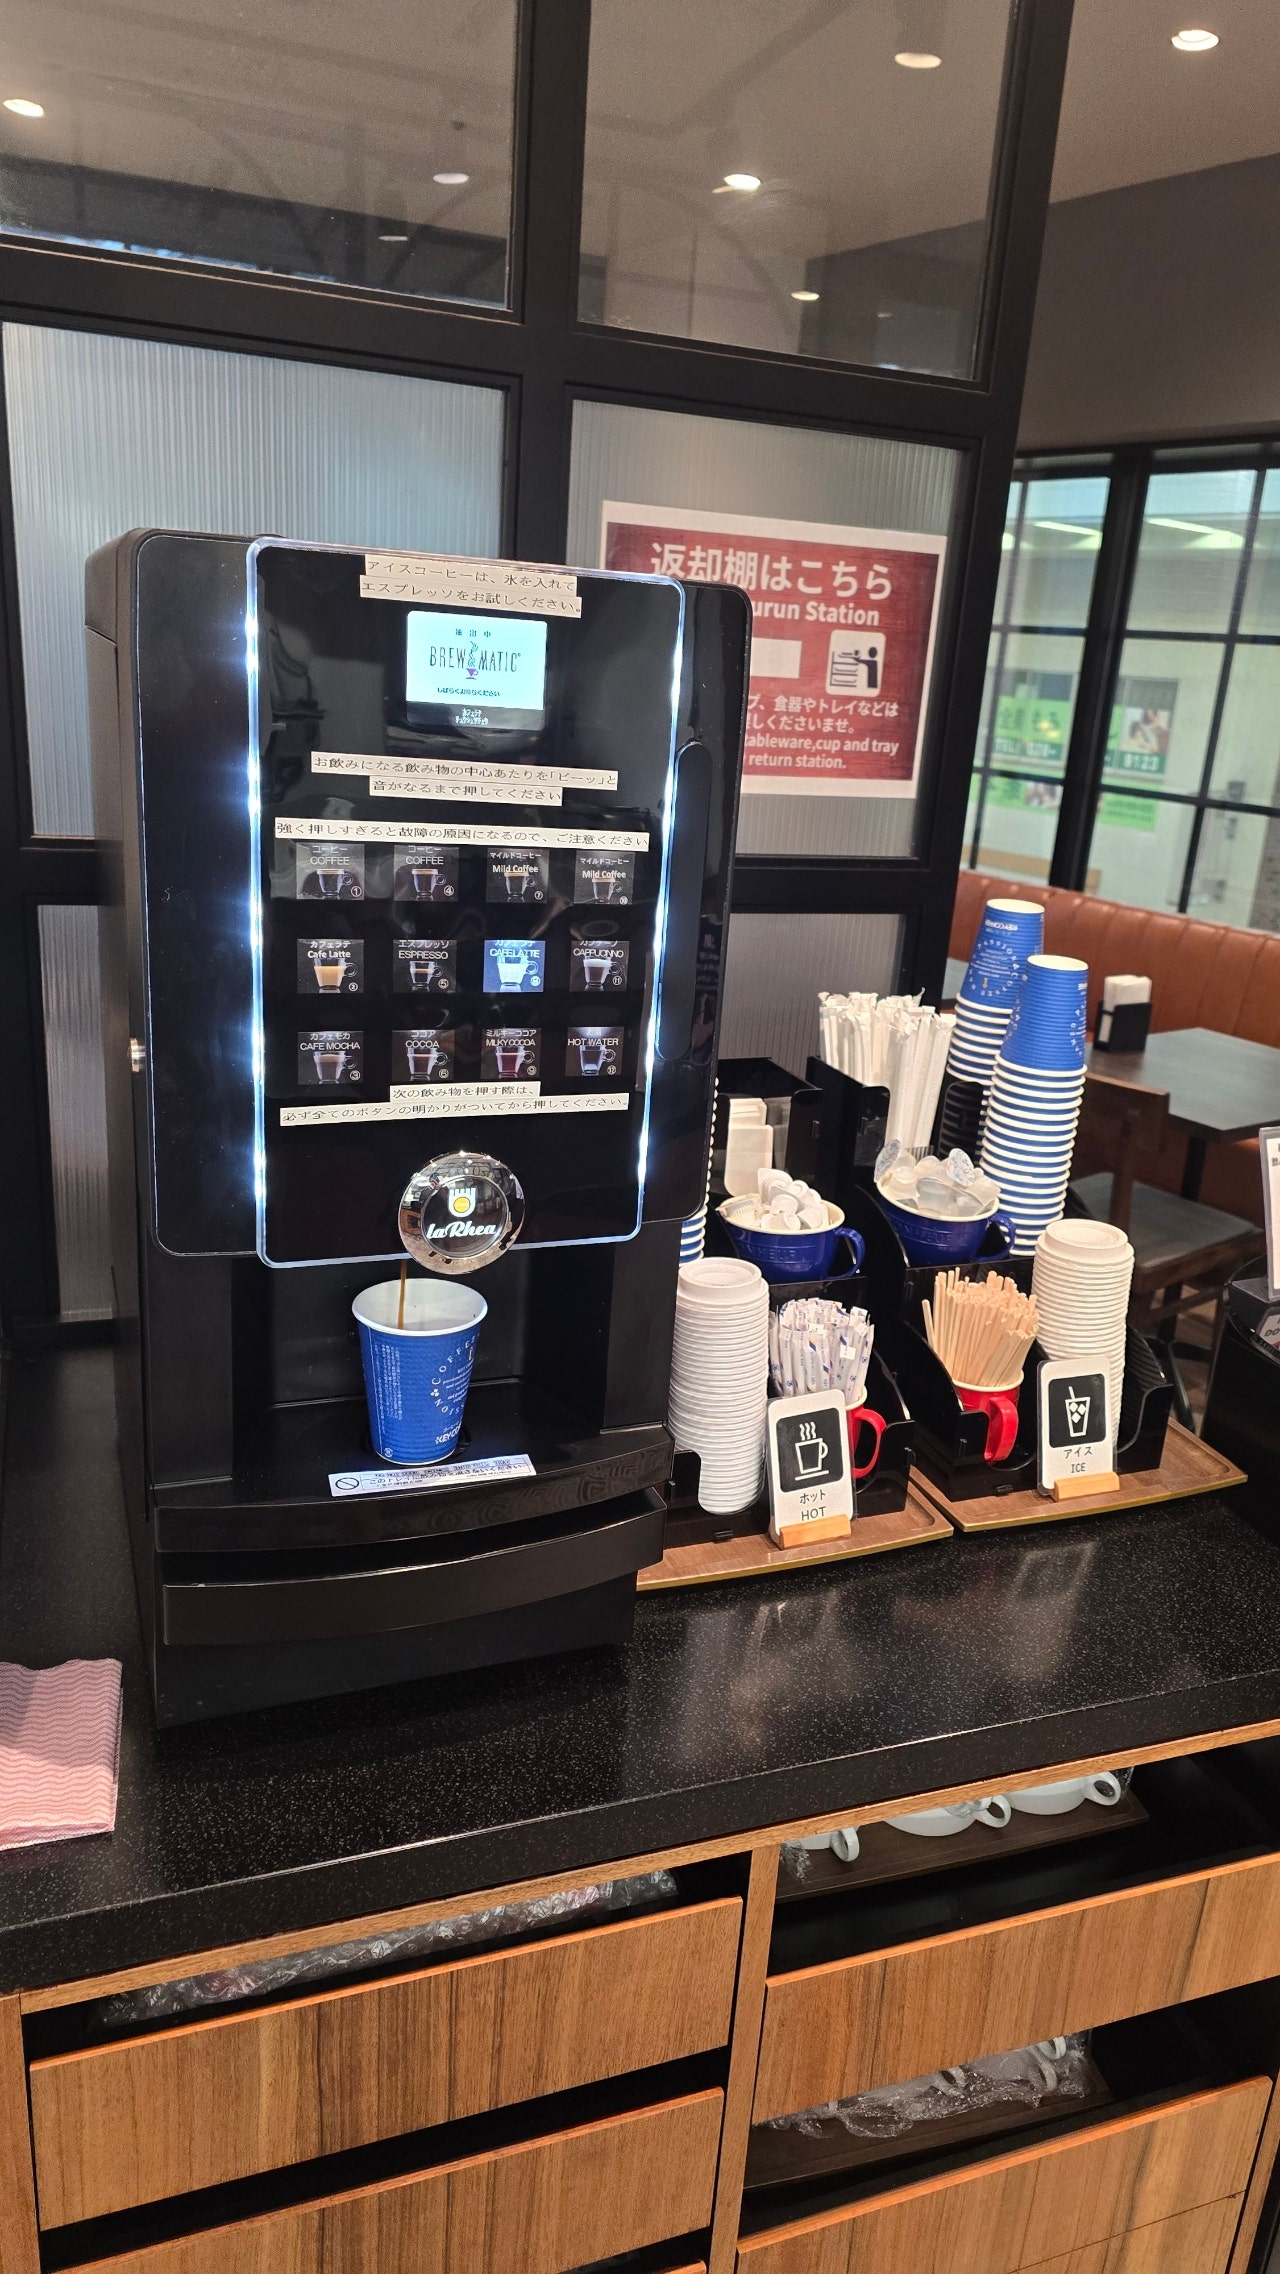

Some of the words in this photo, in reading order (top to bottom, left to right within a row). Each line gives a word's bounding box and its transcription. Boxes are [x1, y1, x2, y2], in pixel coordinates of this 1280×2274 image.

[367, 560, 575, 591] アイスコーヒーは、氷を入れて
[650, 541, 893, 601] 返却棚はこちら
[361, 582, 581, 613] エスプレッソをお試しください。
[805, 600, 880, 626] Station
[429, 645, 466, 669] BREW
[844, 738, 869, 752] and
[871, 740, 900, 757] tray
[749, 753, 792, 767] return
[795, 754, 847, 769] station.
[372, 780, 562, 800] 音がなるまで押してください
[276, 823, 648, 848] 強く押しすぎると故障の原因になるので、ご注意ください
[312, 845, 348, 854] コーヒー
[408, 845, 442, 854] コーヒー
[310, 856, 350, 865] COFFEE
[406, 856, 444, 865] COFFEE
[580, 858, 630, 866] マイルドコーヒー
[492, 865, 511, 873] Mild
[513, 864, 539, 873] Coffee
[582, 870, 600, 879] Mild
[602, 870, 627, 879] Coffee
[310, 941, 351, 949] カフェラテ
[308, 950, 327, 958] Cafe
[329, 950, 351, 958] Latte
[399, 951, 449, 959] ESPRESSO
[310, 1032, 351, 1040] カフェモカ
[411, 1030, 436, 1038] ココア
[485, 1029, 537, 1037] ミルキーココア
[326, 1042, 361, 1050] MOCHA
[405, 1040, 440, 1048] COCOA
[568, 1038, 587, 1046] HOT
[588, 1038, 619, 1046] WATER
[393, 1085, 534, 1099] 次の飲み物を押す際は、
[282, 1098, 629, 1122] 必ず全てのボタンの明かりがついてから押してください。
[1063, 1446, 1093, 1460] アイス
[1070, 1462, 1086, 1474] ICE
[799, 1488, 826, 1504] ホット
[801, 1505, 827, 1521] HOT
